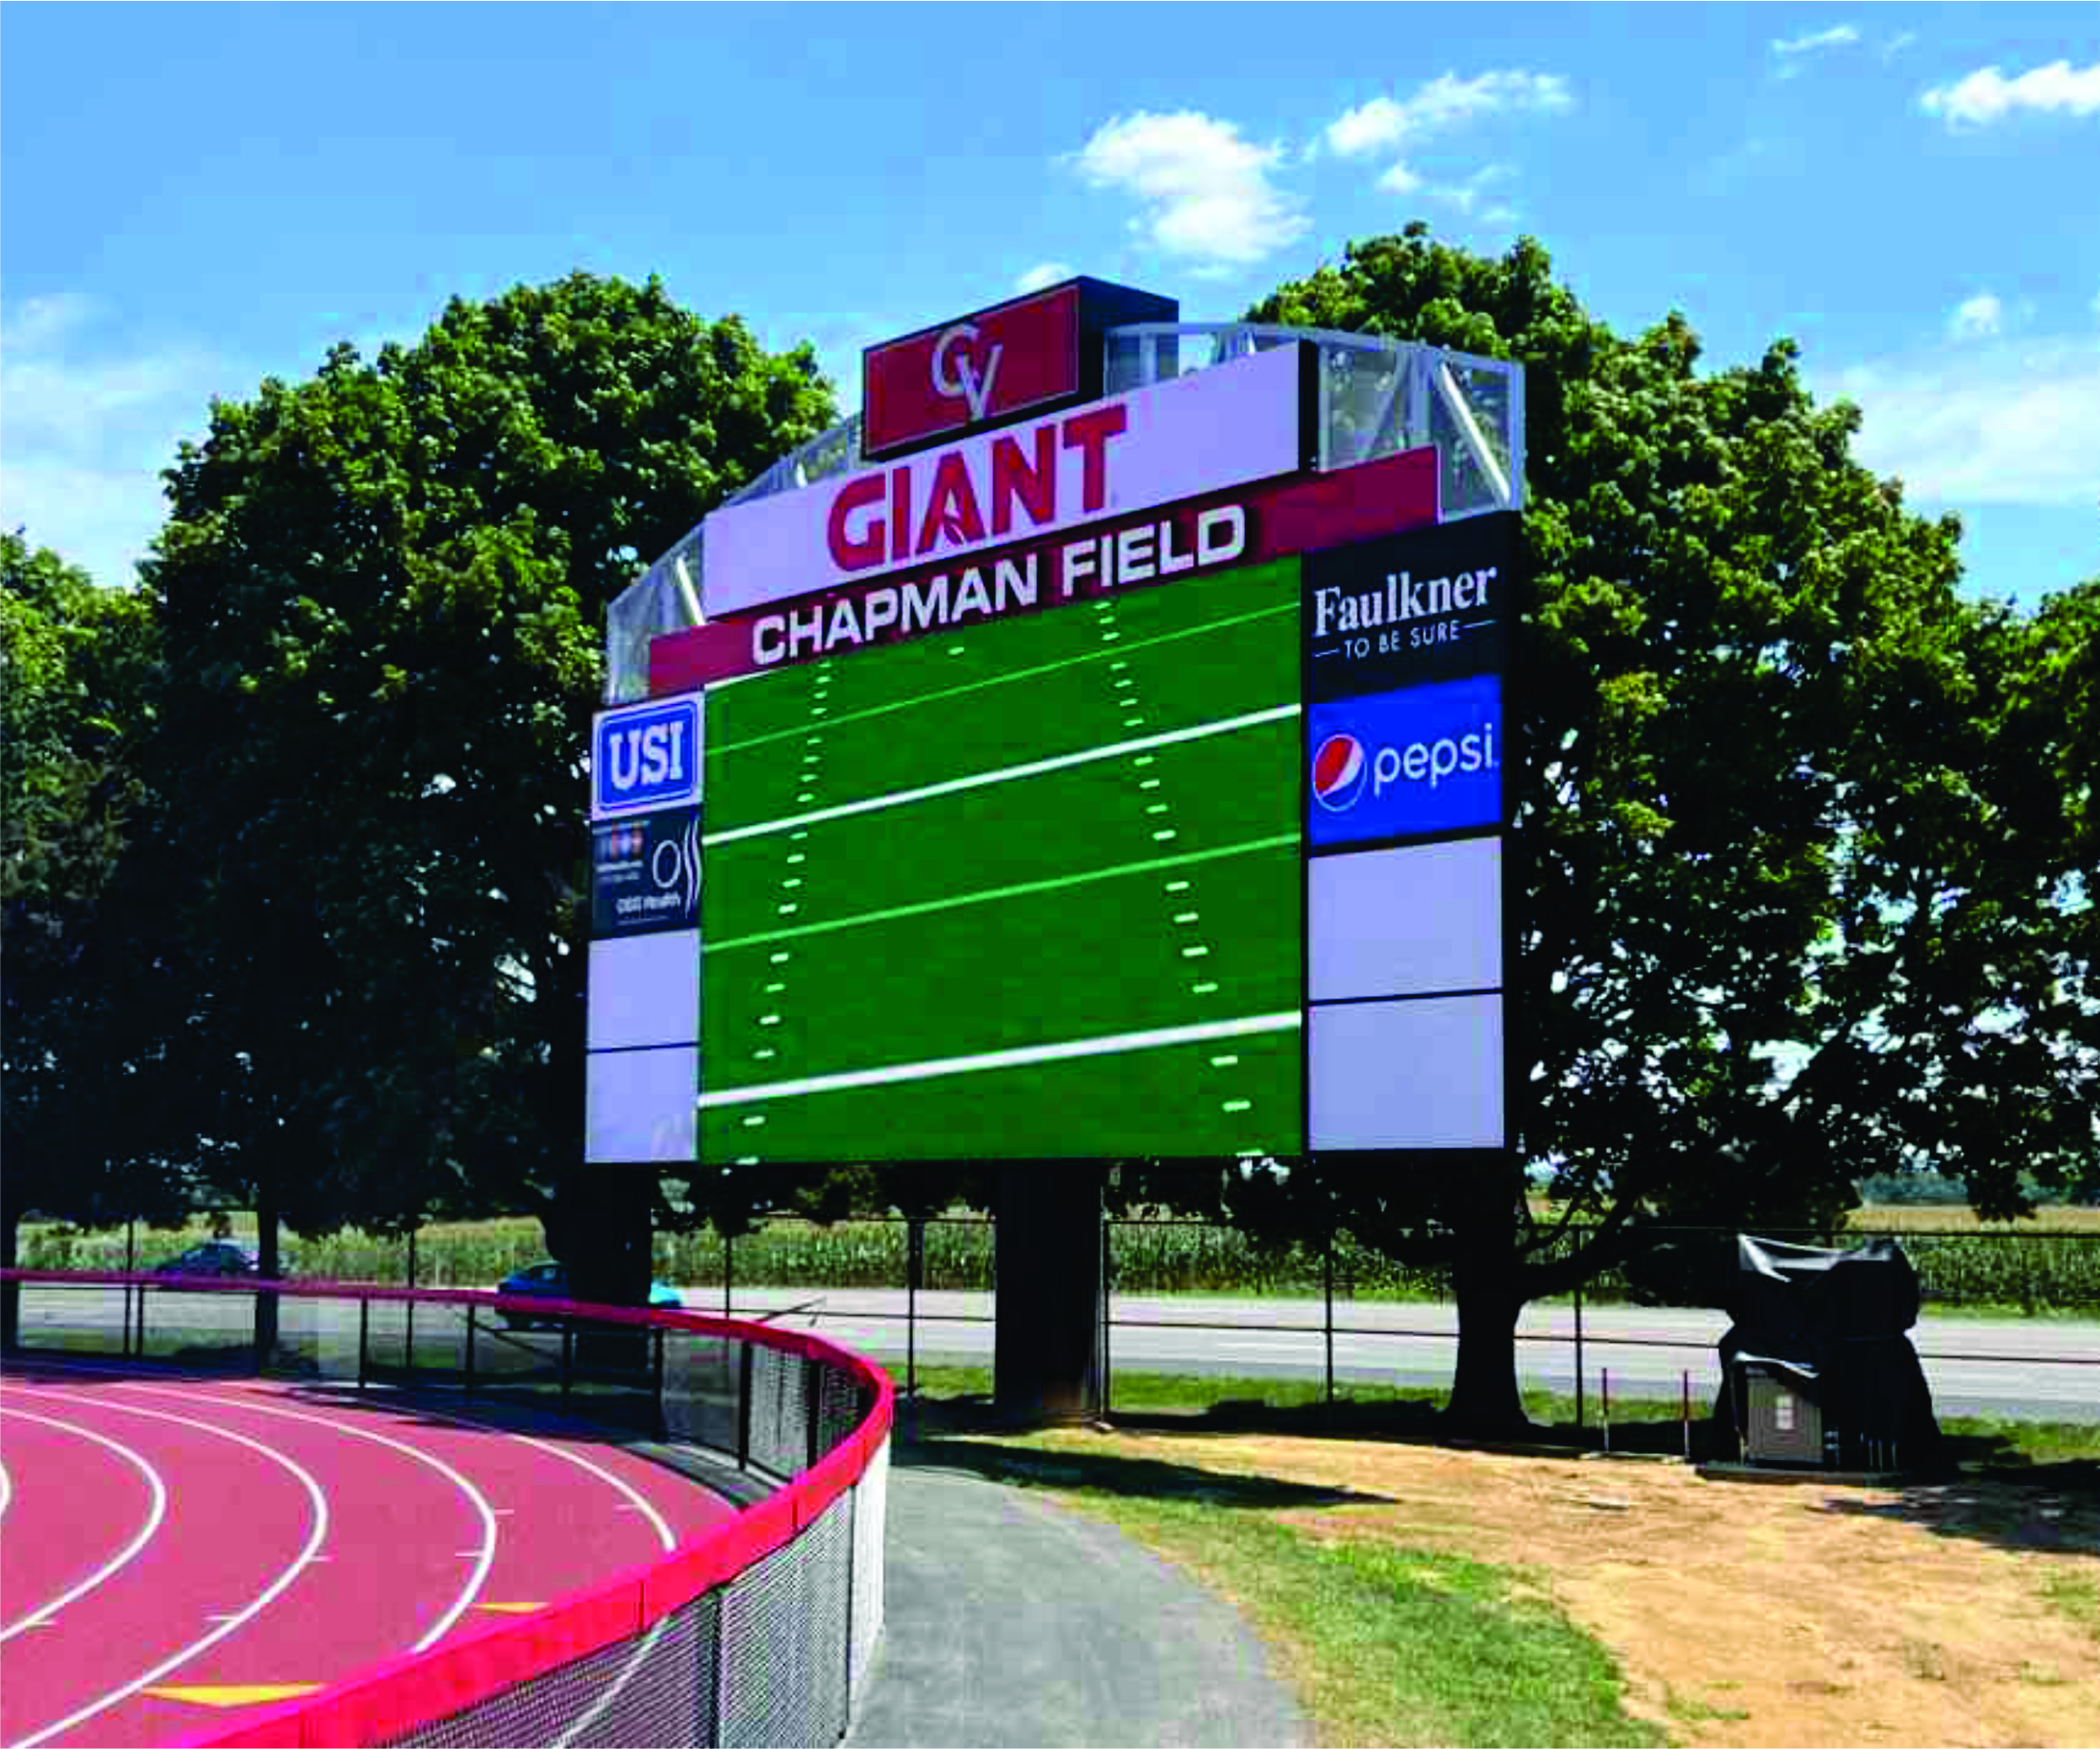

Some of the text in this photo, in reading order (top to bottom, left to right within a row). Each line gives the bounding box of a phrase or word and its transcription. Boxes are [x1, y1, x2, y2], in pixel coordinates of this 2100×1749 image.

[828, 404, 1127, 571] GIANT
[752, 505, 1245, 665] CHAPMAN FIELD
[1312, 567, 1497, 637] Faulkner
[1344, 619, 1461, 658] TO BE SURE
[610, 722, 683, 790] USI
[1375, 723, 1493, 797] pepsi
